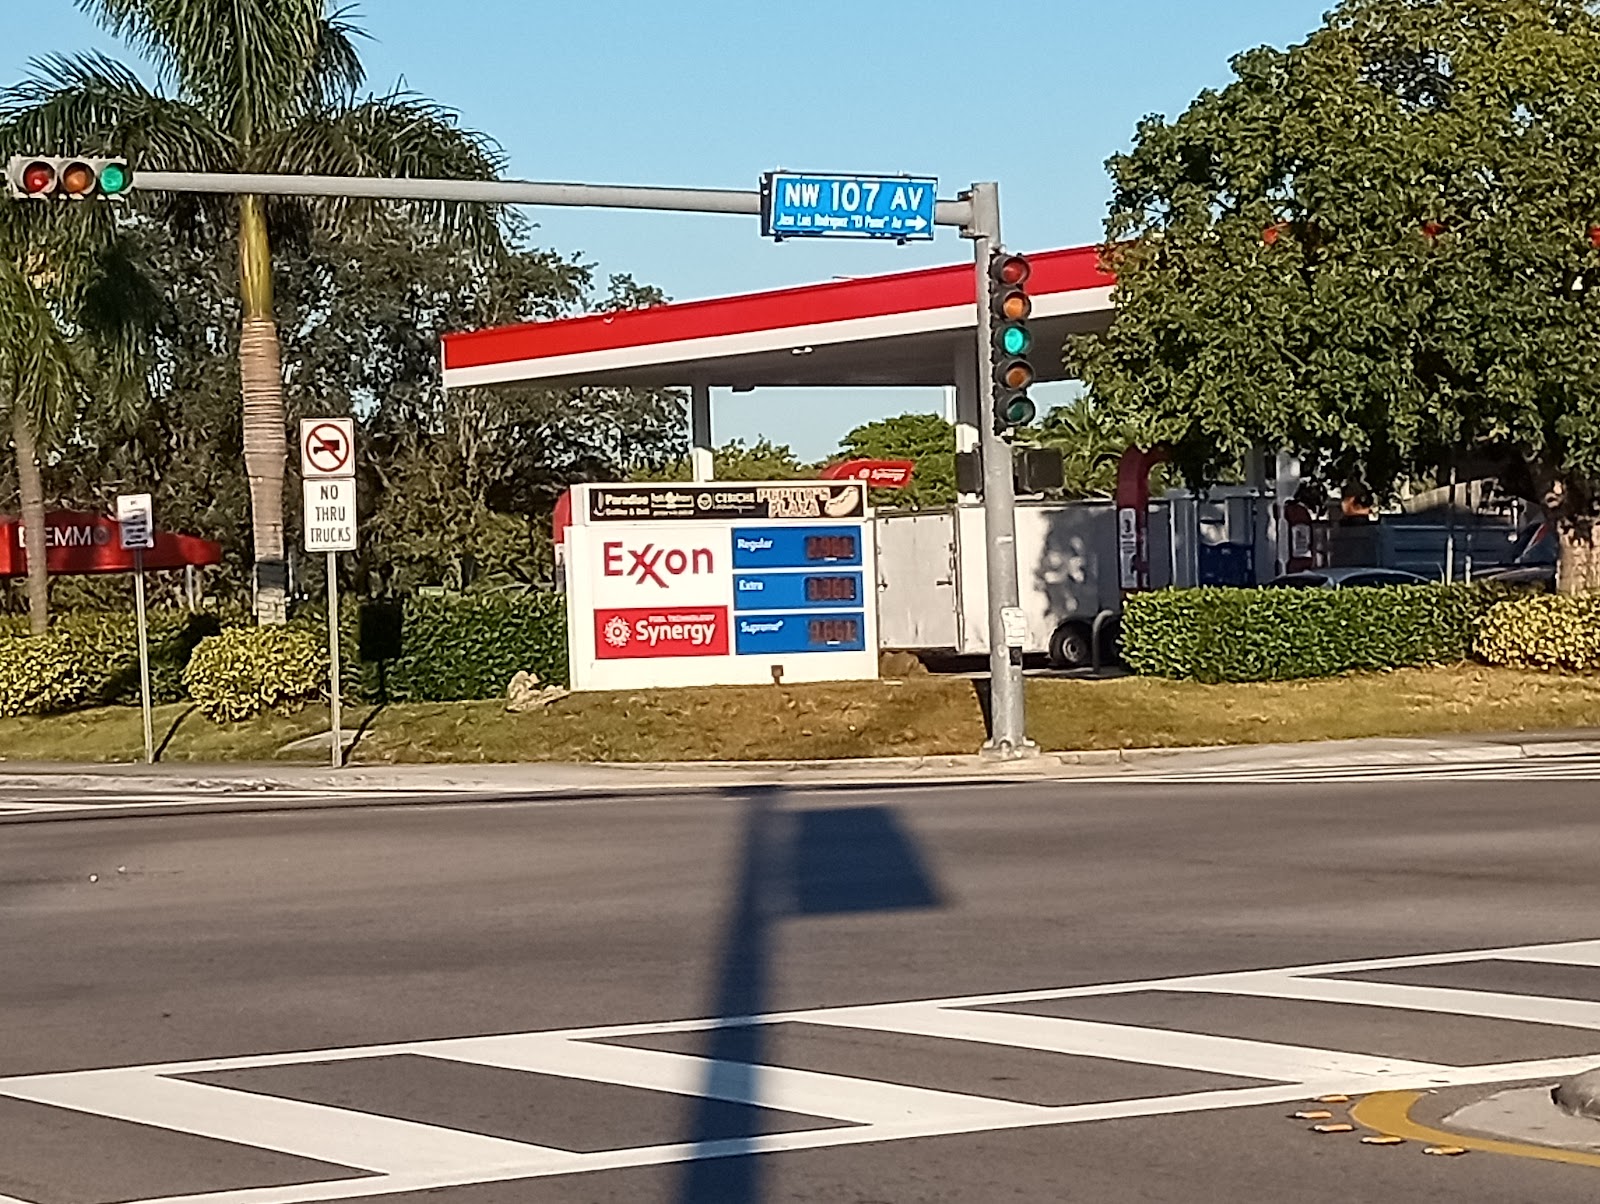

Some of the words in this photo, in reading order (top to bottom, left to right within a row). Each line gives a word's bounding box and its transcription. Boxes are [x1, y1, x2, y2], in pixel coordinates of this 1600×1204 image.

[785, 182, 820, 208] NW
[831, 182, 880, 213] 107
[890, 186, 924, 211] AV
[320, 485, 339, 501] NO
[315, 506, 346, 522] THRU
[768, 500, 820, 517] PLAZA
[310, 527, 352, 543] TRUCKS
[737, 537, 773, 552] Regular
[603, 541, 714, 588] Exxon
[739, 579, 763, 591] Extra
[635, 619, 716, 647] Synergy
